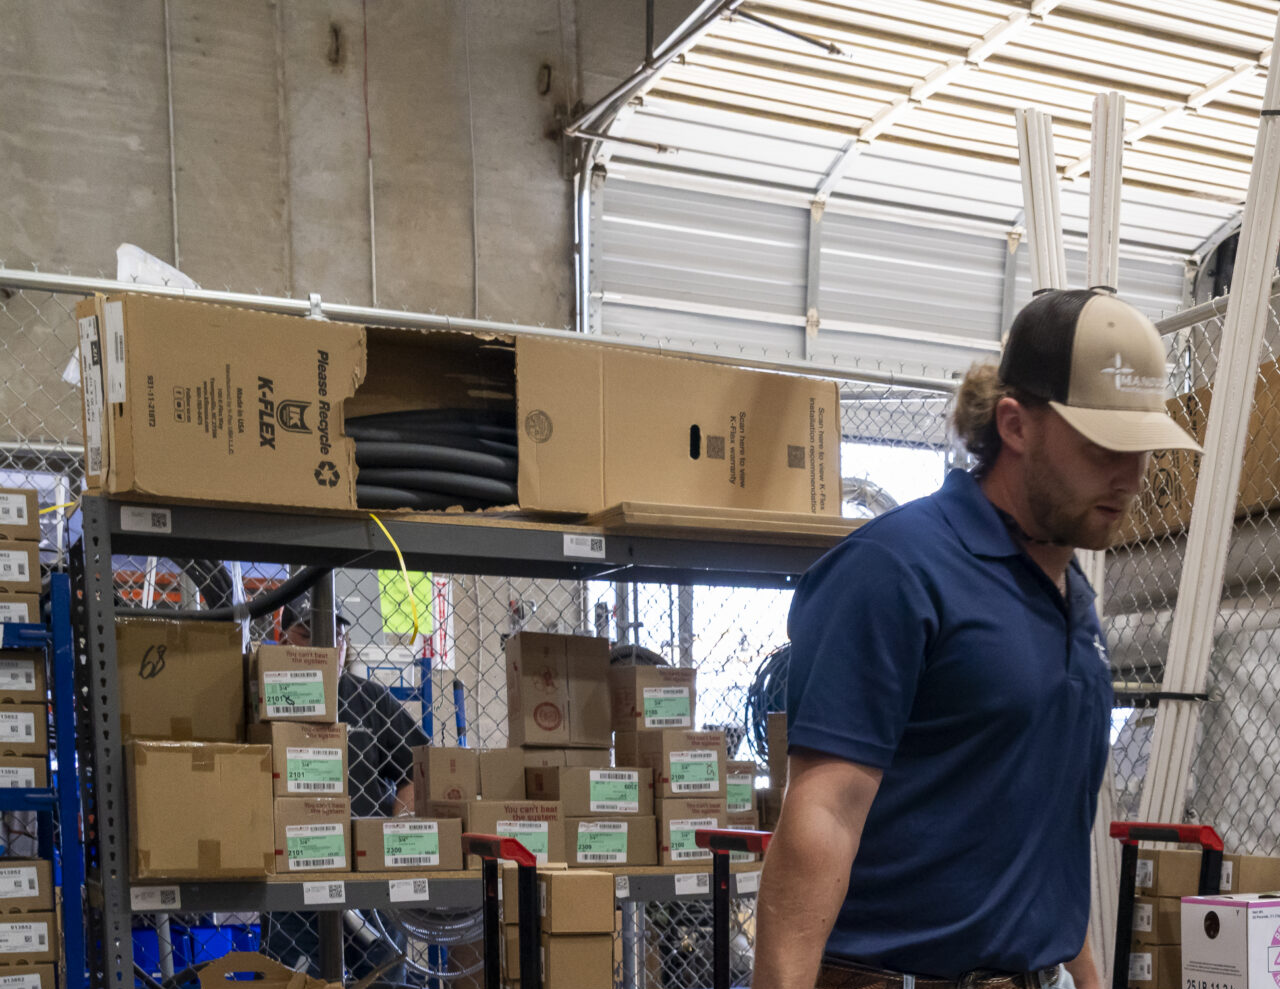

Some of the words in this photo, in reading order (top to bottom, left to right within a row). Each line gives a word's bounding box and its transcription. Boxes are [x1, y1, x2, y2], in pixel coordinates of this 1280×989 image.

[317, 350, 330, 396] Please
[258, 376, 275, 450] K-FLEX
[318, 401, 331, 455] Recycle
[728, 447, 737, 485] warranty
[740, 458, 746, 466] to
[819, 452, 825, 460] to
[504, 805, 520, 813] You
[523, 806, 538, 814] can't
[541, 805, 558, 813] beat
[512, 813, 525, 821] the
